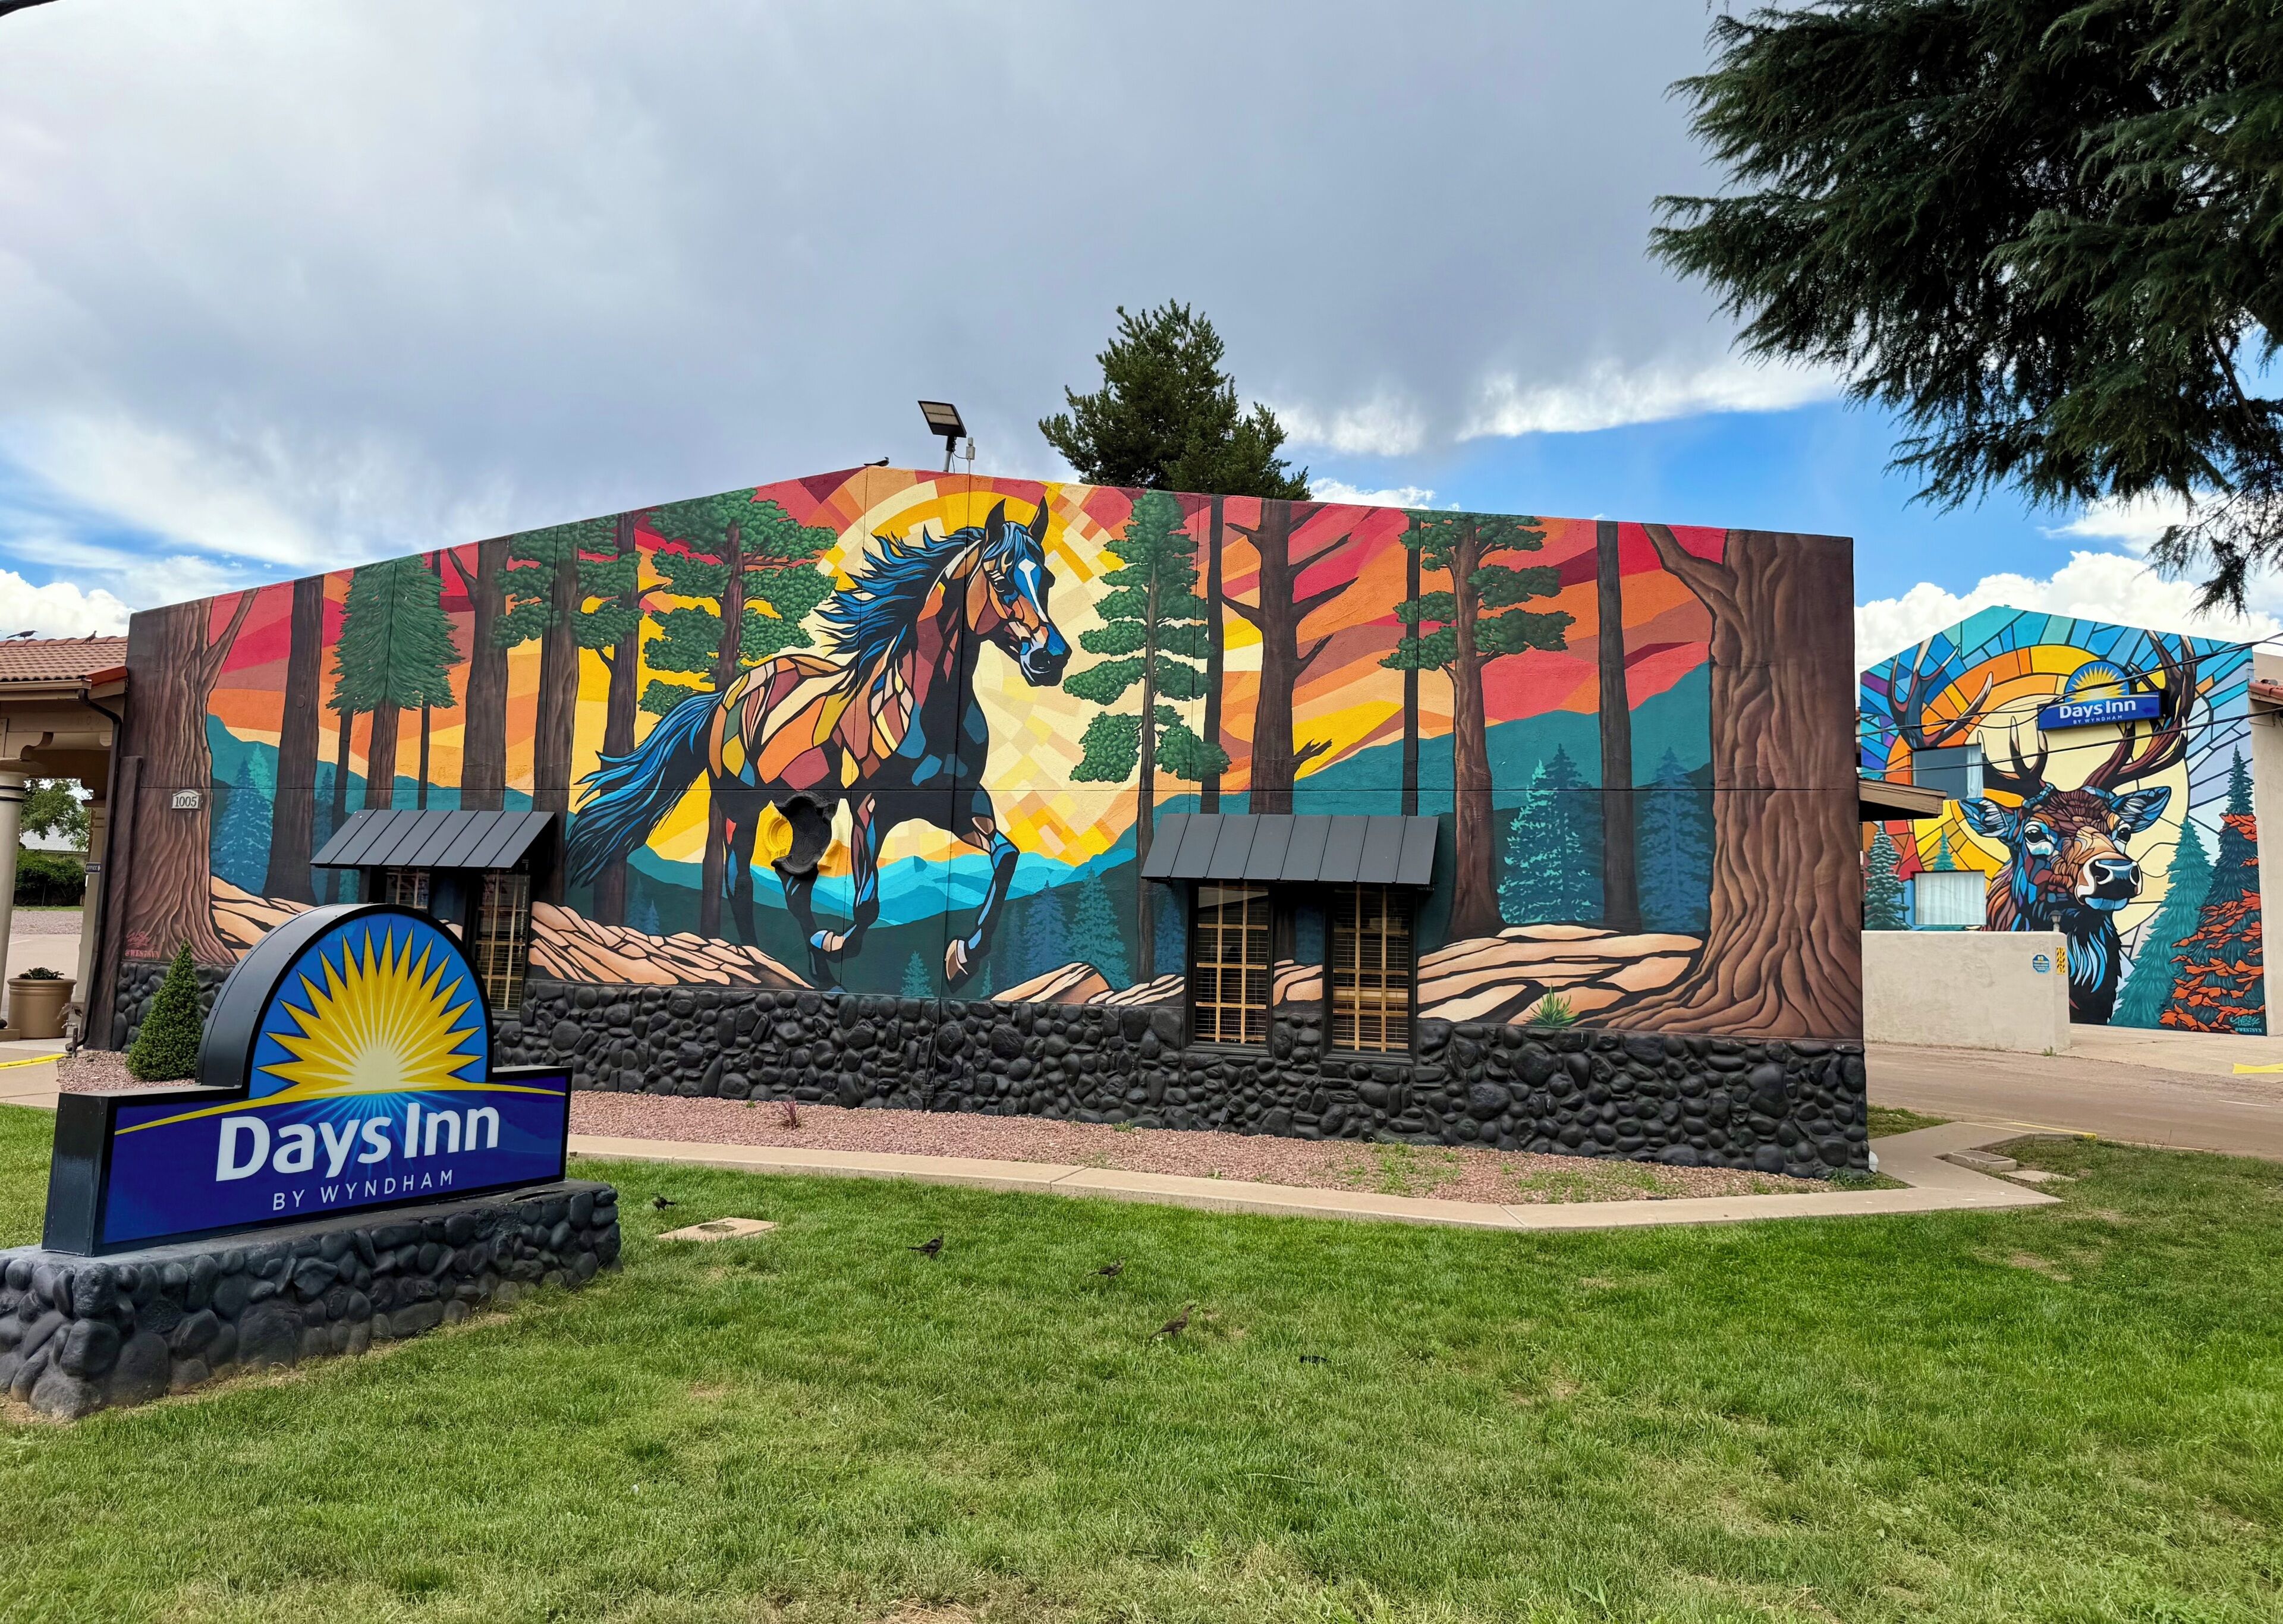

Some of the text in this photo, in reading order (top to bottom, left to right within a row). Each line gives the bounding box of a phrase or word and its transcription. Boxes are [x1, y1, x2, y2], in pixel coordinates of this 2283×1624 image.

[2059, 700, 2136, 719] Days Inn
[2084, 715, 2122, 723] WYNDHAM
[175, 797, 197, 807] 1005
[216, 1102, 499, 1182] Days Inn
[272, 1169, 453, 1211] BY WYNDHAM
